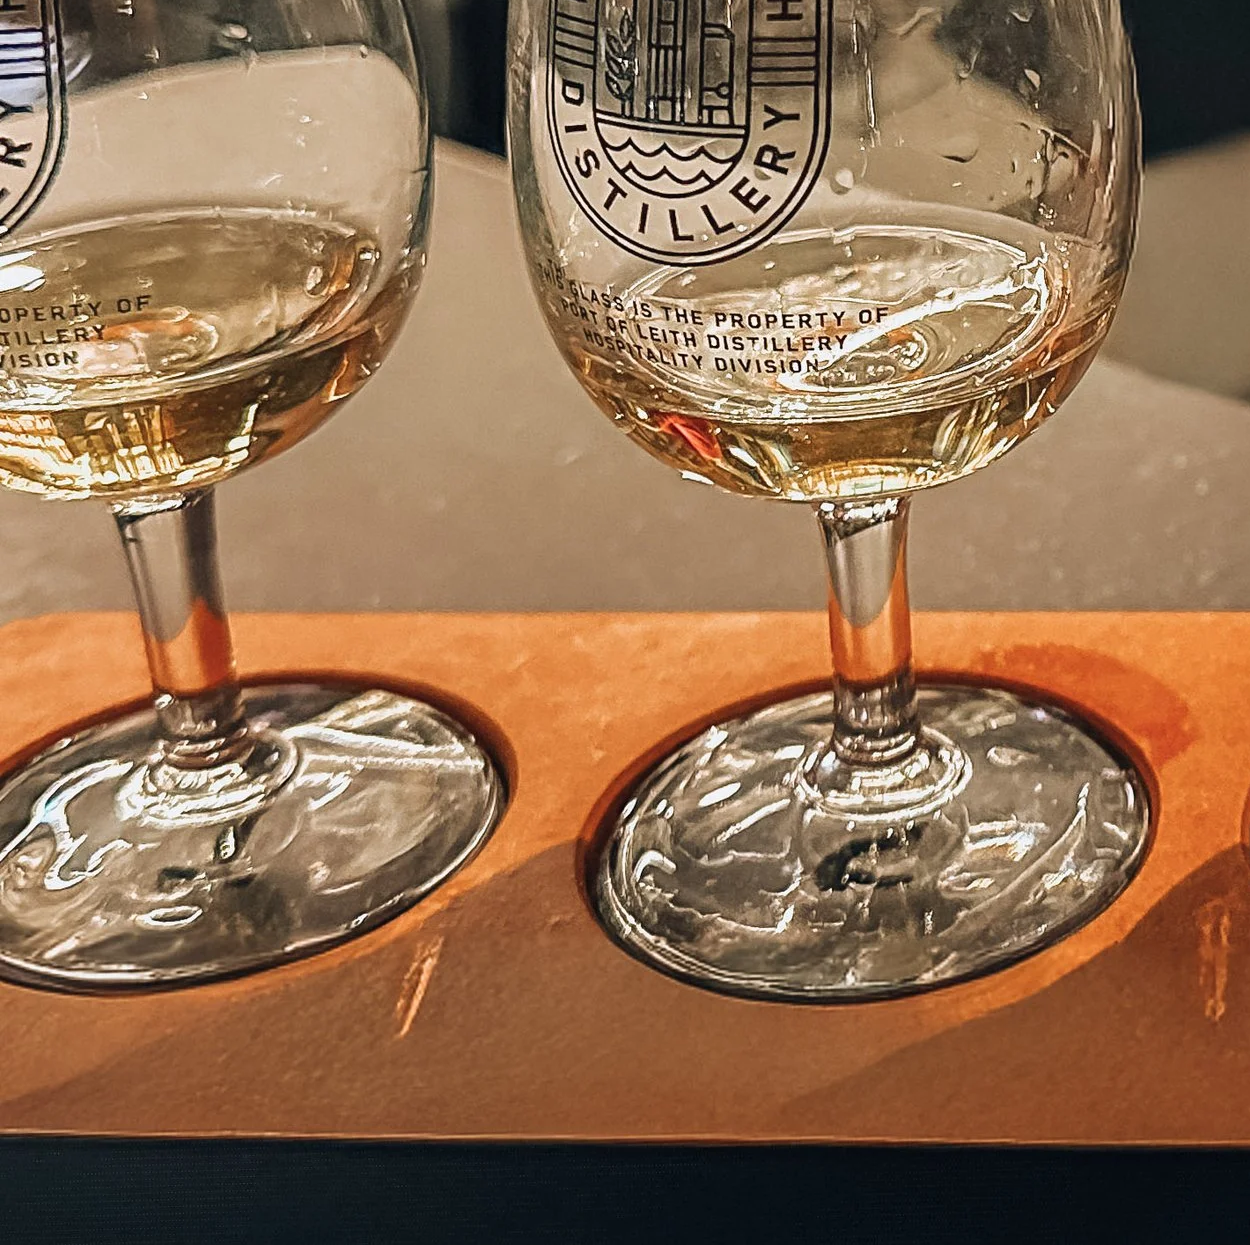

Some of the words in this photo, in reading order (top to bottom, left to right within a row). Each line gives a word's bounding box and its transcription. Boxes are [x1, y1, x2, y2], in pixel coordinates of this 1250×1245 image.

[562, 82, 801, 242] DISTILLERY
[117, 295, 152, 314] OF
[561, 299, 598, 325] PORT
[606, 316, 627, 334] OF
[637, 323, 697, 347] LEITH
[707, 334, 848, 352] DISTILLERY
[568, 279, 625, 312] GLASS
[632, 300, 652, 318] IS
[660, 306, 704, 326] THE
[714, 310, 846, 329] PROPERTY
[858, 307, 889, 324] OF
[583, 327, 703, 370] HOSPITALITY
[714, 357, 820, 374] DIVISION
